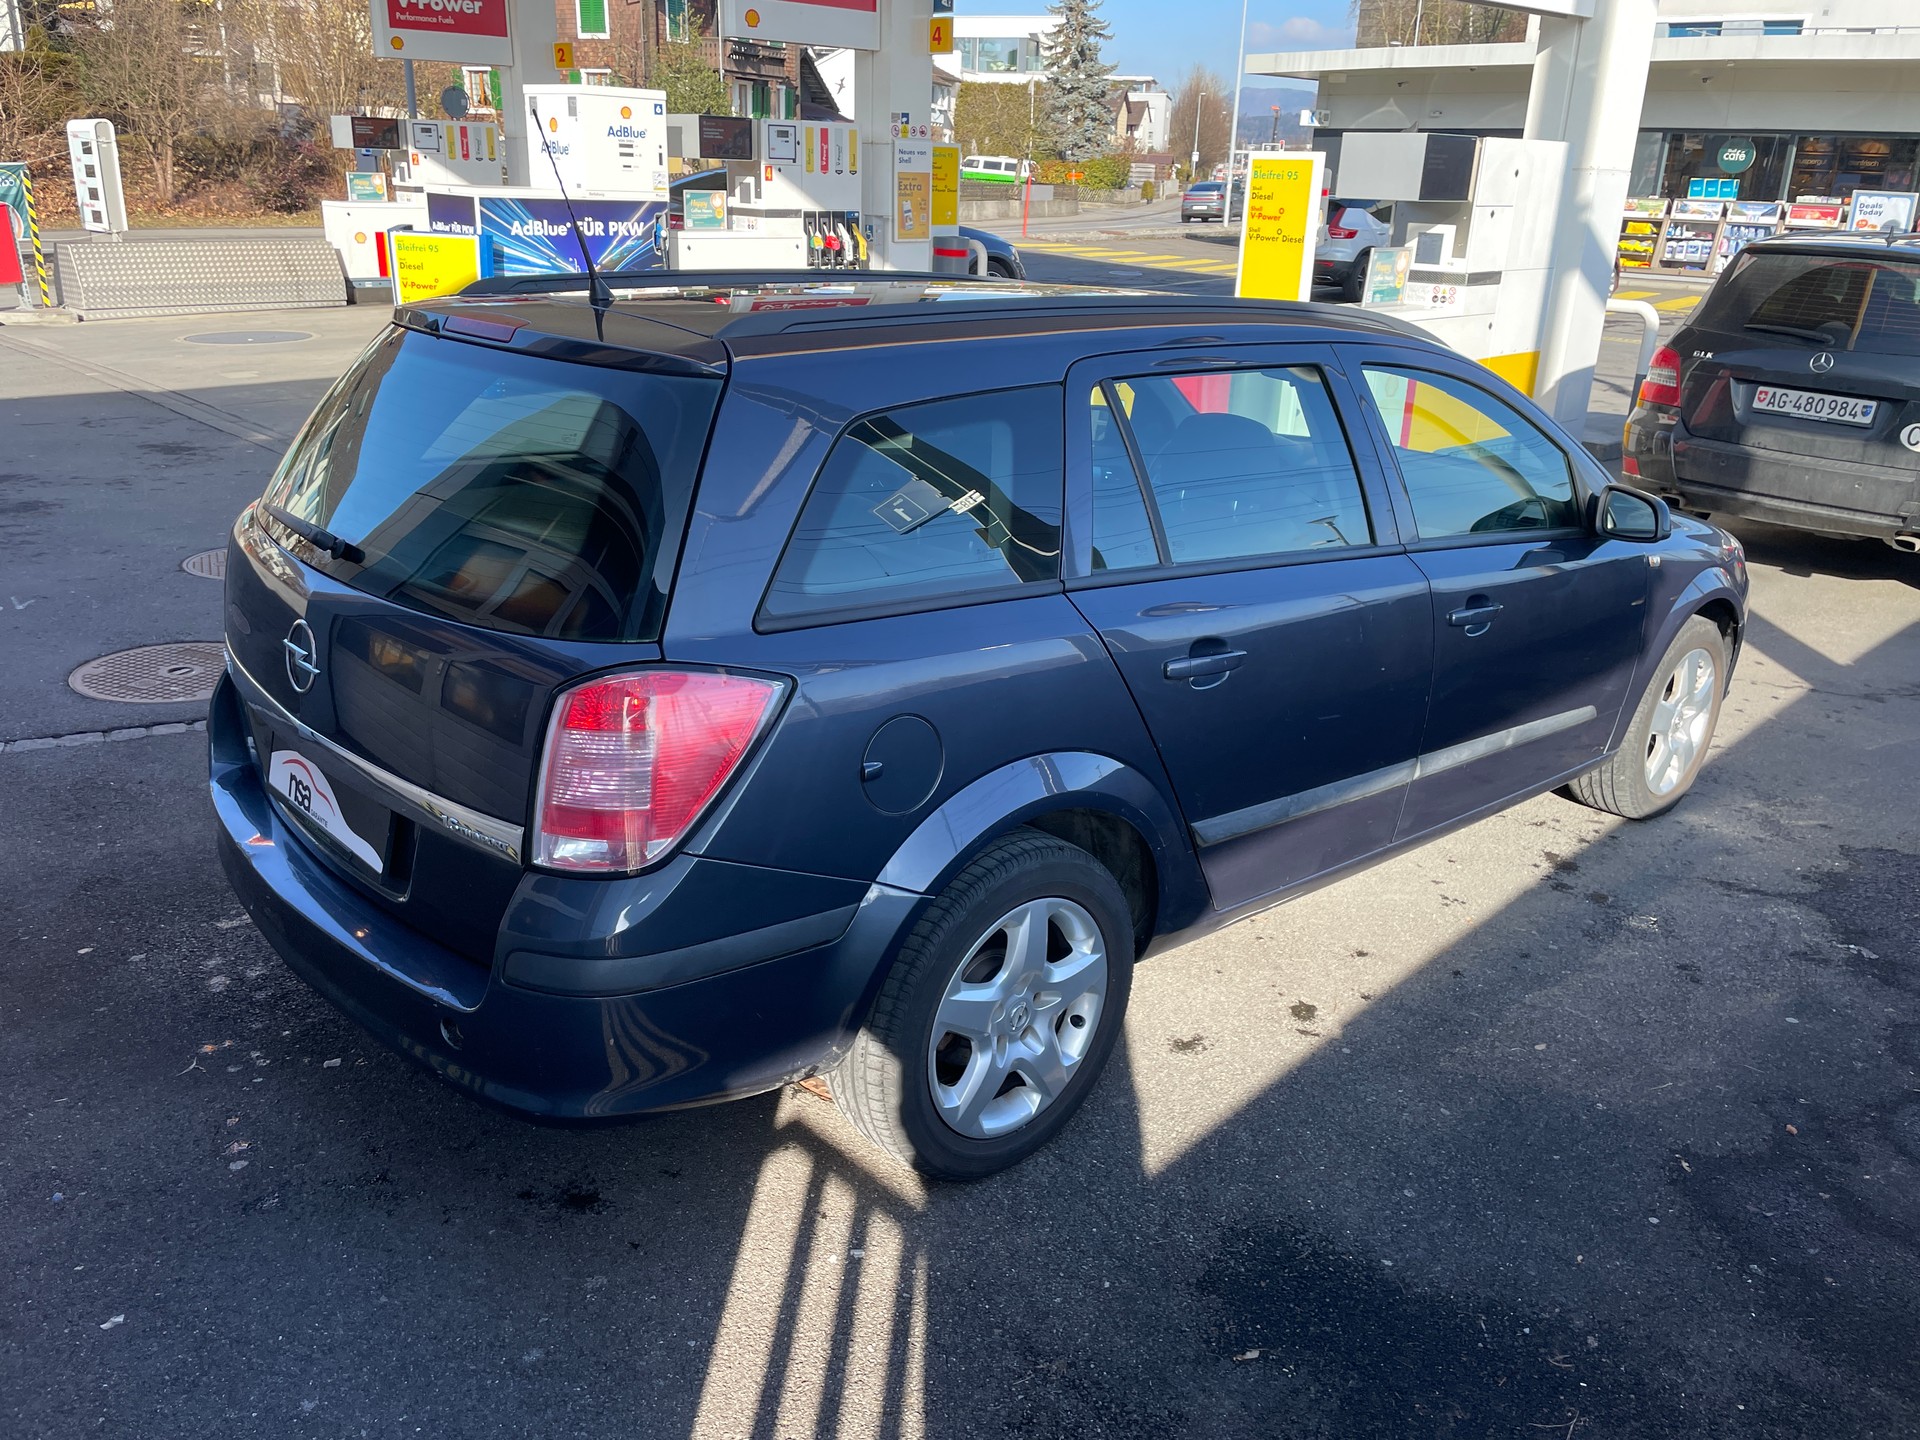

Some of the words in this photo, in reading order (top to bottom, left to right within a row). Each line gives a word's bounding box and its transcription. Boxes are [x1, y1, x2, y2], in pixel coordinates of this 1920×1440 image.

[396, 12, 437, 23] Performance
[438, 15, 455, 25] Fuels
[932, 26, 942, 45] 4
[557, 48, 566, 62] 2
[655, 105, 662, 113] 6
[607, 125, 646, 138] AdBlue
[412, 154, 418, 164] 2
[1723, 150, 1746, 161] café
[766, 167, 772, 179] 4
[1253, 170, 1285, 180] Bleifrei
[1287, 171, 1299, 181] 95
[898, 181, 922, 191] Extra
[1251, 192, 1274, 200] Diesel
[1250, 212, 1281, 221] V-Power
[609, 221, 645, 237] PKW
[1248, 233, 1279, 242] V-Power
[1282, 235, 1304, 244] Diesel
[397, 243, 426, 252] Bleifrei
[428, 245, 439, 253] 95
[400, 261, 423, 270] Diesel
[402, 281, 437, 290] V-Power
[1692, 350, 1714, 359] GLK
[288, 772, 311, 814] nsa
